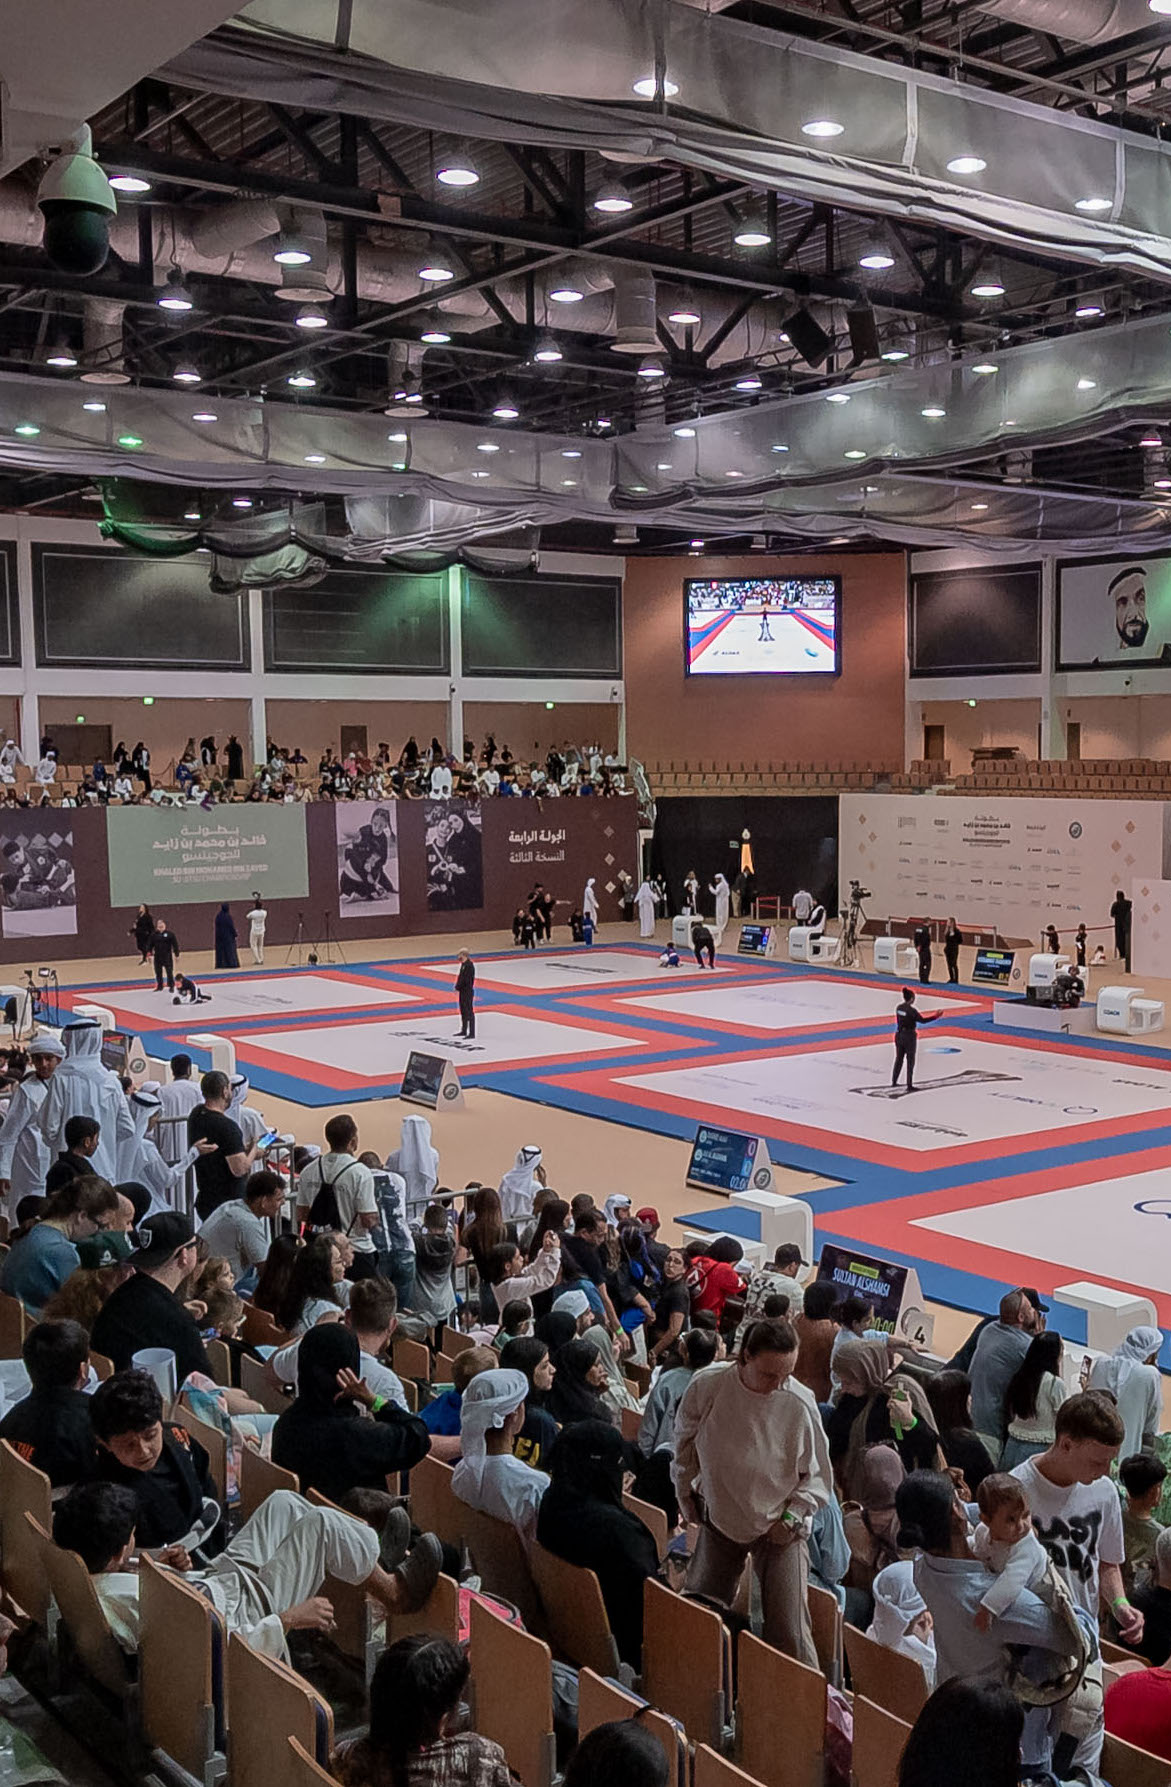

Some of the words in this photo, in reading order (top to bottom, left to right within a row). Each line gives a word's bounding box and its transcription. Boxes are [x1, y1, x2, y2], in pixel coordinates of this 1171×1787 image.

[539, 829, 566, 845] الجولة
[832, 1267, 857, 1286] SULTAN
[914, 1326, 926, 1345] 4
